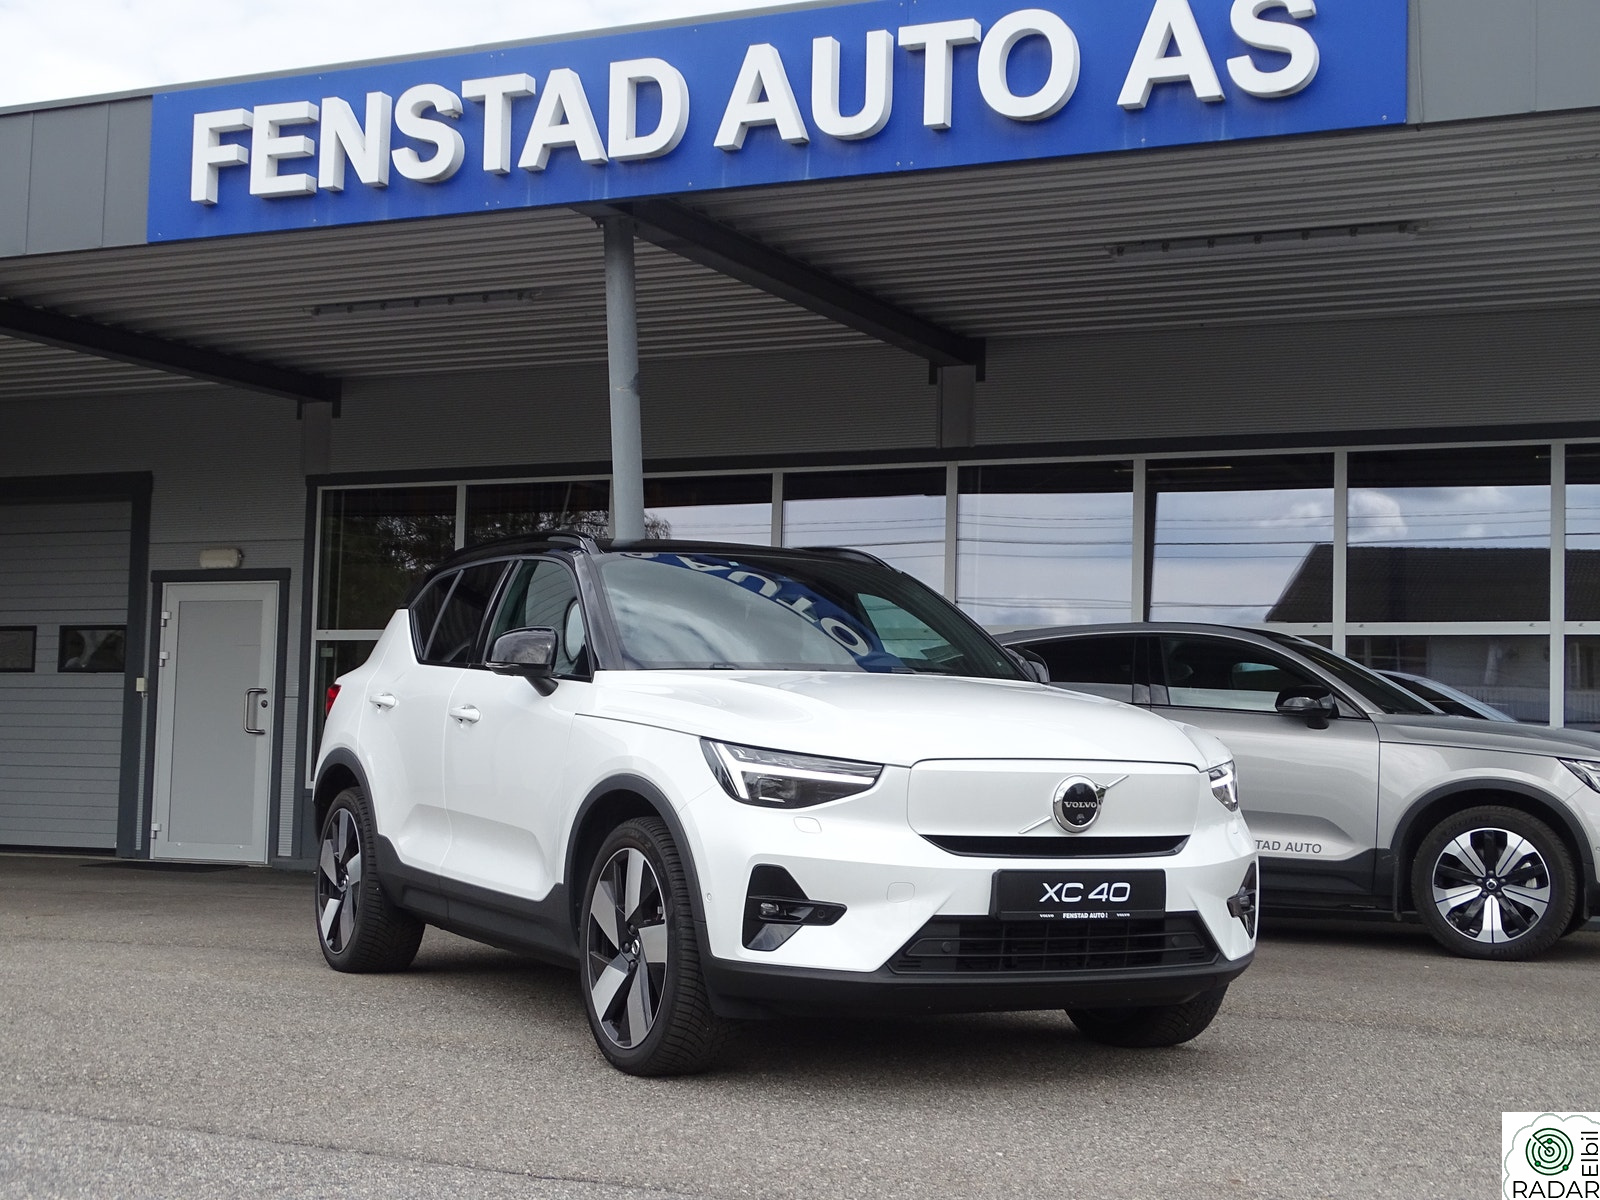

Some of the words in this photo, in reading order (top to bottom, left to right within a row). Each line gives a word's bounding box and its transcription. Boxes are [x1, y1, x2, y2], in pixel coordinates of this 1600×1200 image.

[191, 57, 690, 206] FENSTAD
[712, 8, 1081, 151] AUTO
[1116, 0, 1321, 111] AS
[1255, 839, 1281, 851] TAD
[1284, 842, 1322, 854] AUTO
[1039, 882, 1084, 903] XC
[1088, 882, 1131, 903] 40
